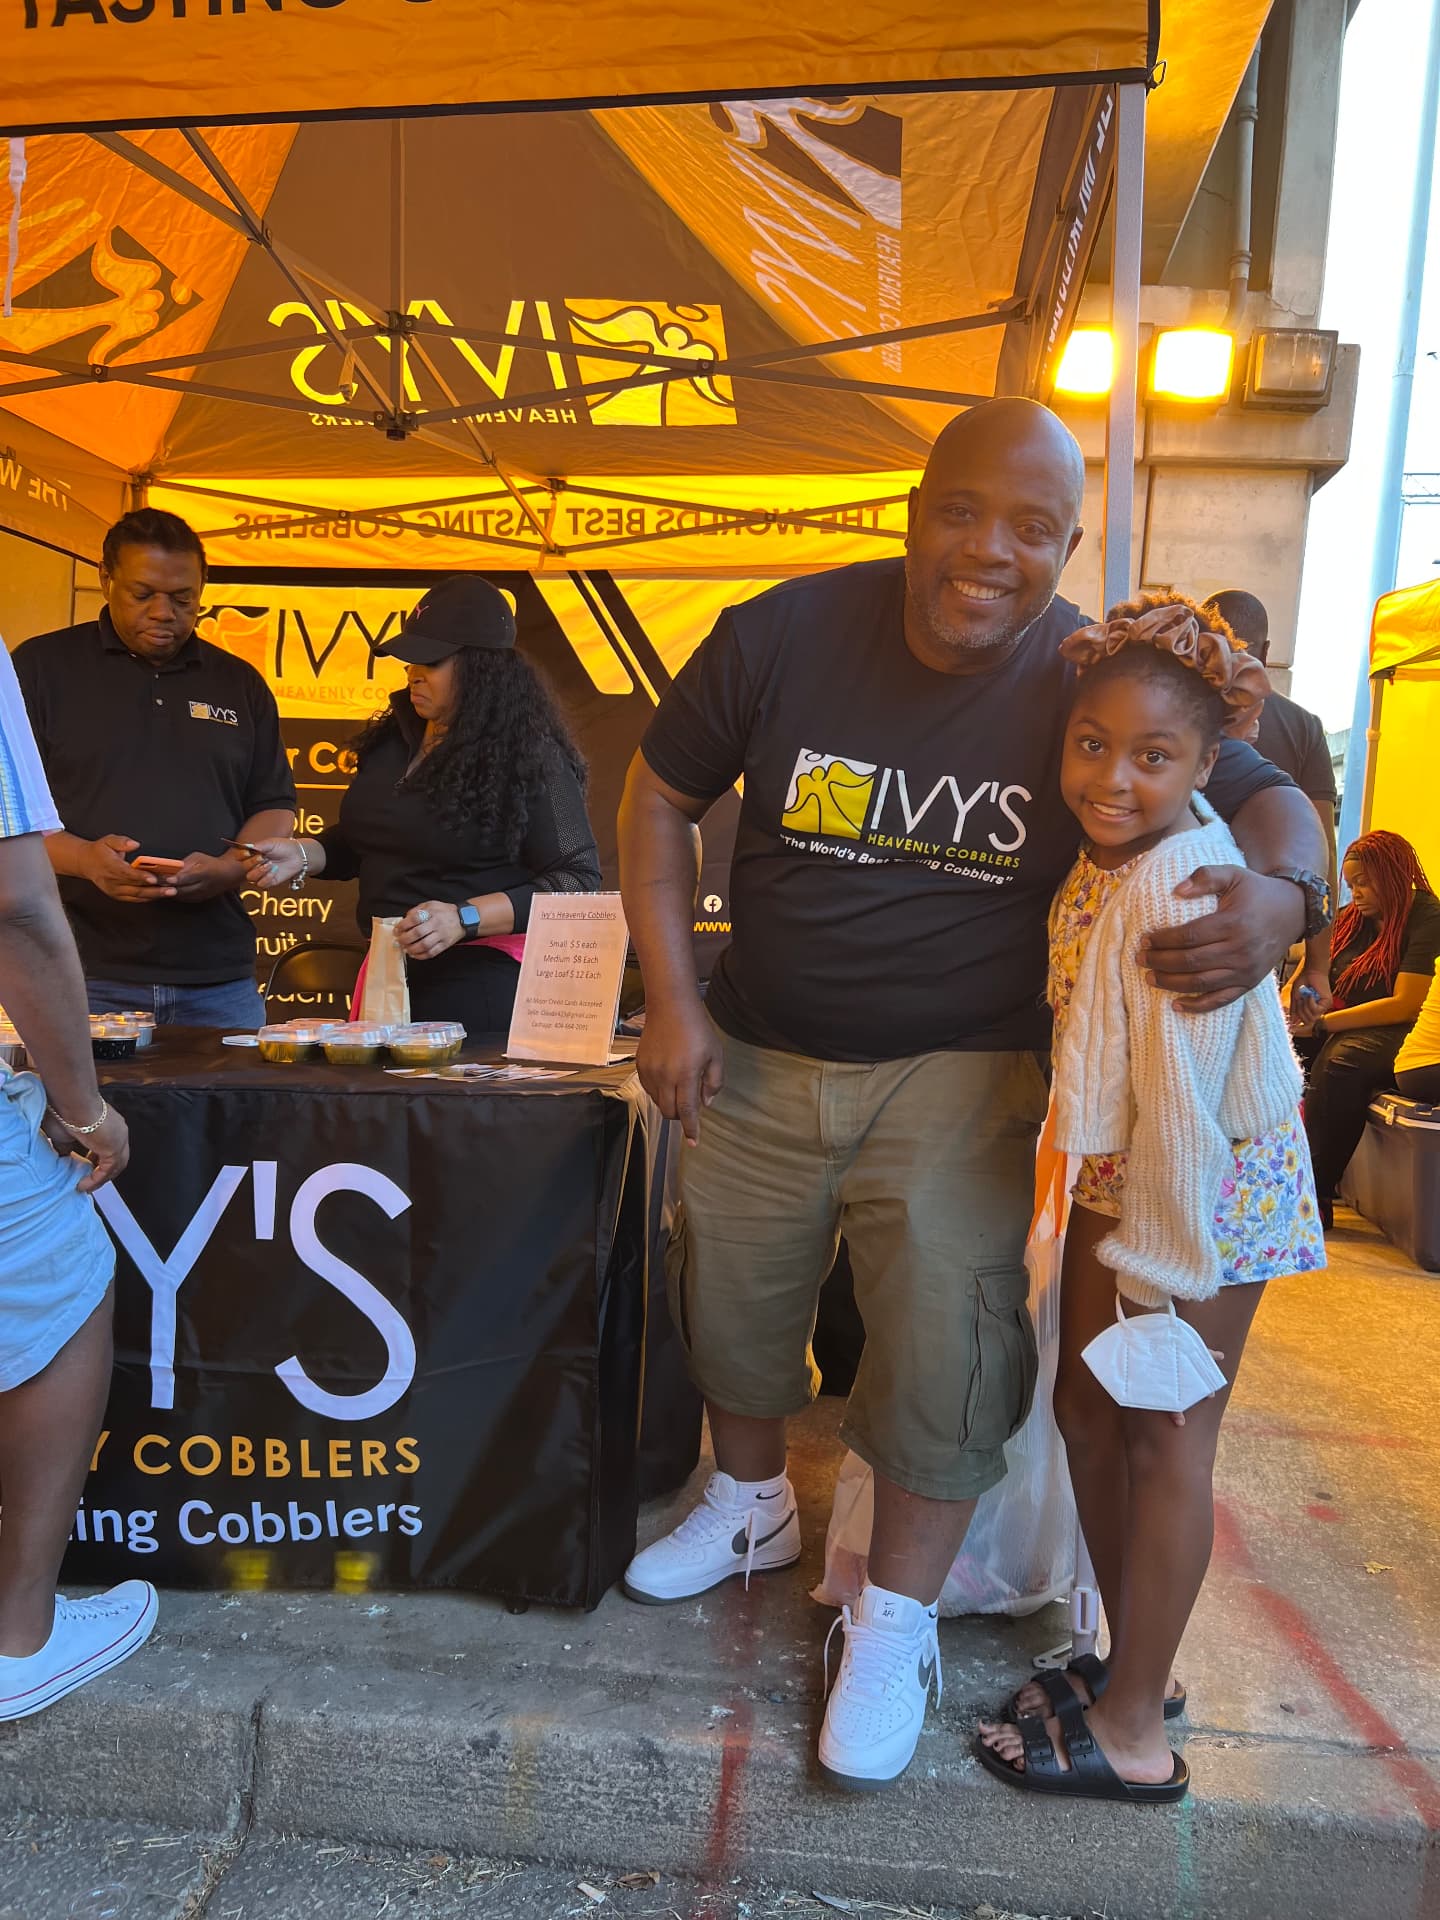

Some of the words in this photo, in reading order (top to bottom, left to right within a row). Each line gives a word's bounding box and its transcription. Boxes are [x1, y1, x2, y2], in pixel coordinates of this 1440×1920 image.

[275, 686, 355, 700] HEAVENLY
[293, 808, 324, 835] le
[870, 767, 1033, 852] IVY'S
[809, 841, 856, 861] World's
[867, 834, 940, 855] HEAVENLY
[945, 847, 1021, 869] COBBLERS
[240, 890, 333, 923] Cherry
[557, 911, 587, 921] Heavenly
[588, 911, 617, 920] Cobblers
[550, 940, 568, 949] Small
[581, 940, 598, 950] each
[543, 954, 570, 963] Medium
[583, 956, 598, 965] Each
[536, 970, 554, 979] Large
[555, 970, 569, 979] Loaf
[92, 1160, 417, 1421] Y'S
[133, 1434, 422, 1479] COBBLERS
[68, 1496, 159, 1554] ing
[178, 1500, 423, 1545] Cobblers
